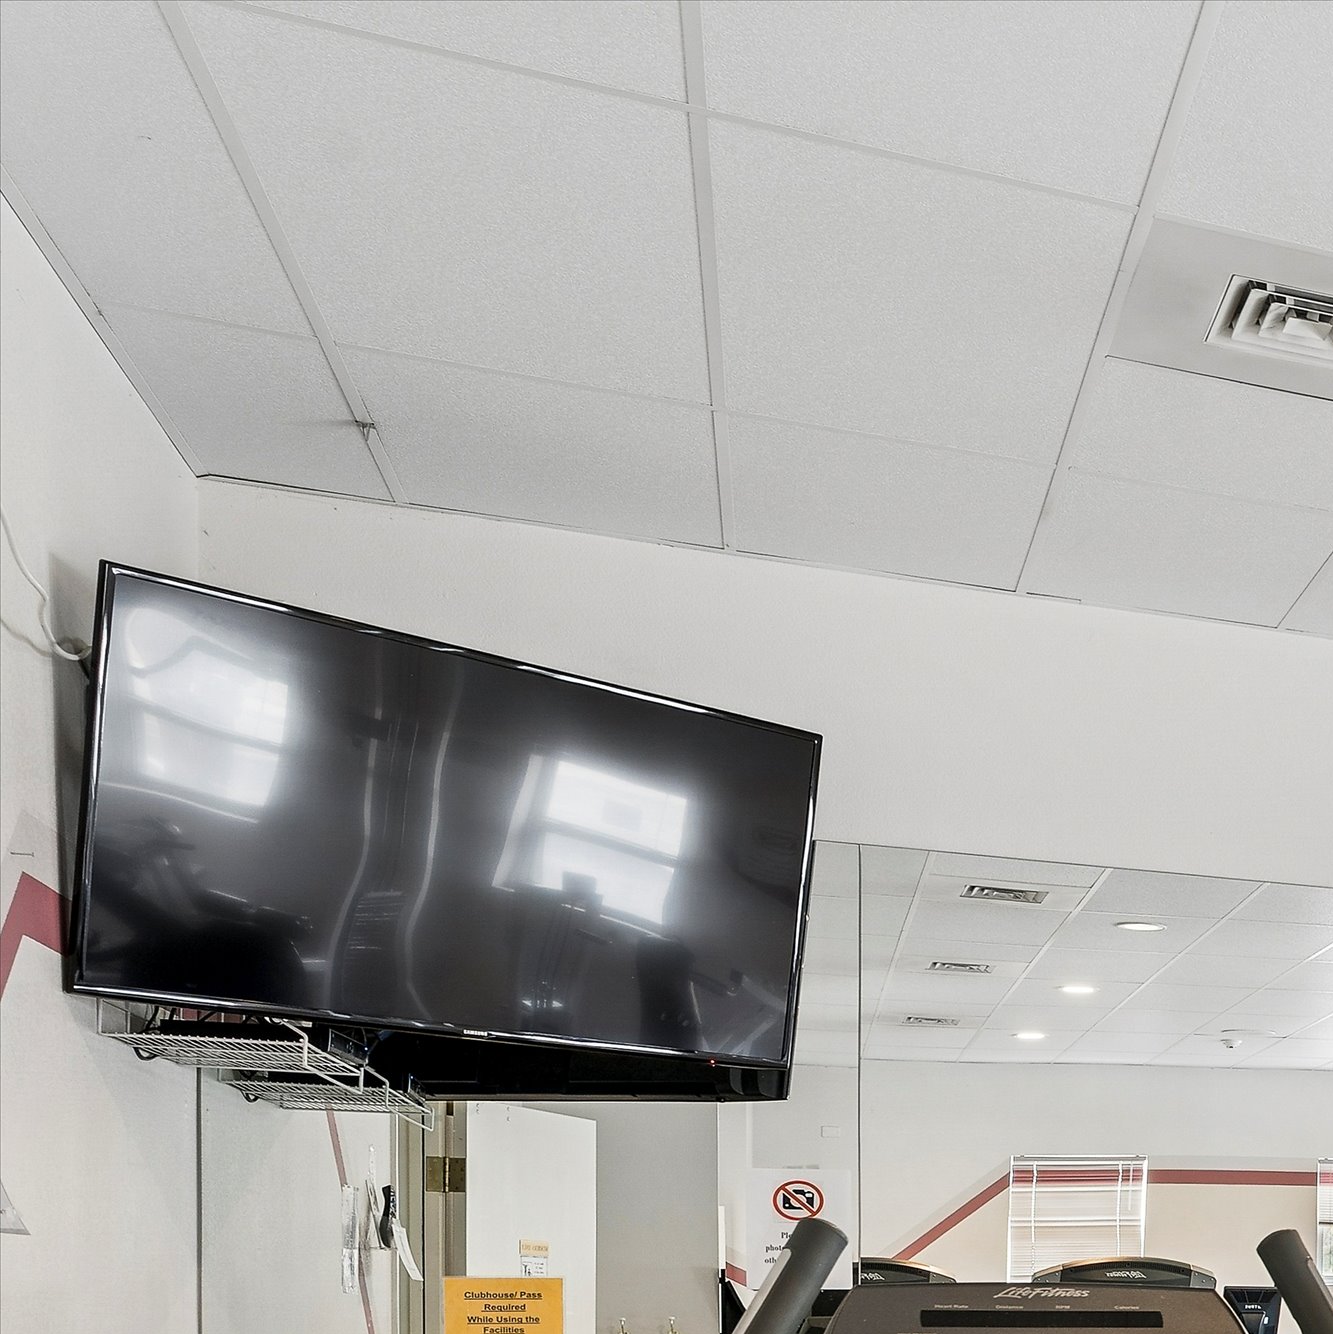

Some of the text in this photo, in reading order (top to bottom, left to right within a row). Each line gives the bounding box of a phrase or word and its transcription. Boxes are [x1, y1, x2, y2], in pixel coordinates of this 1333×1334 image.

[464, 1291, 543, 1299] Clubhouse/ Pass
[993, 1287, 1090, 1299] LifeFitness
[484, 1304, 526, 1312] Required
[496, 1316, 523, 1324] Using
